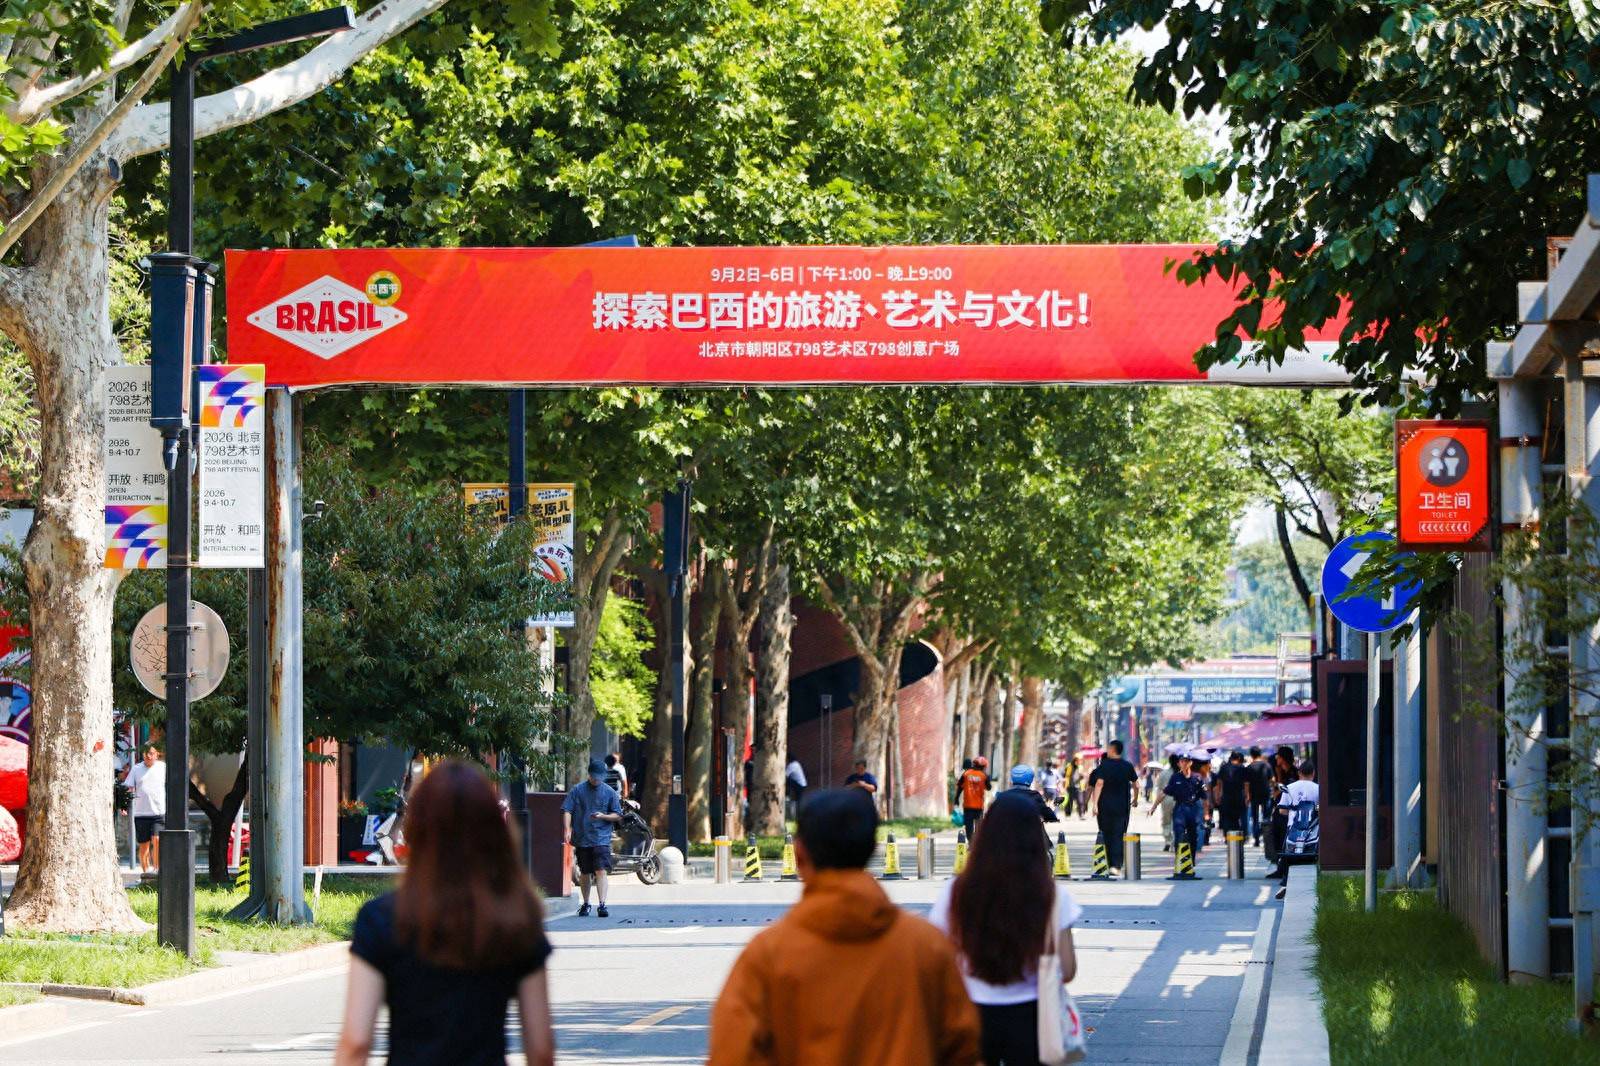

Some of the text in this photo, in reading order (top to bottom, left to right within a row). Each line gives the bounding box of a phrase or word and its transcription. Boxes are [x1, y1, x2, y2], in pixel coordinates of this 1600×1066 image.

[807, 266, 872, 283] 下午1:00
[887, 266, 952, 283] 晚上9:00
[592, 290, 1090, 330] 探索巴西的旅游、艺术与文化!
[276, 300, 384, 334] BRASIL
[698, 341, 960, 358] 北京市朝阳区798艺术区798创意广场
[108, 381, 137, 393] 2026
[108, 439, 130, 447] 2026
[204, 431, 261, 443] 2026 北京
[108, 448, 141, 456] 9.4-10.7
[204, 445, 261, 457] 798艺术节
[108, 473, 131, 485] 开放
[142, 473, 166, 485] 和鸣
[107, 494, 151, 502] INTERACTION
[203, 489, 225, 497] 2026
[203, 499, 236, 507] 9.4-10.7
[1418, 492, 1471, 510] 卫生间
[1431, 511, 1458, 519] TOILET
[203, 524, 226, 536] 开放
[237, 524, 261, 536] 和鸣
